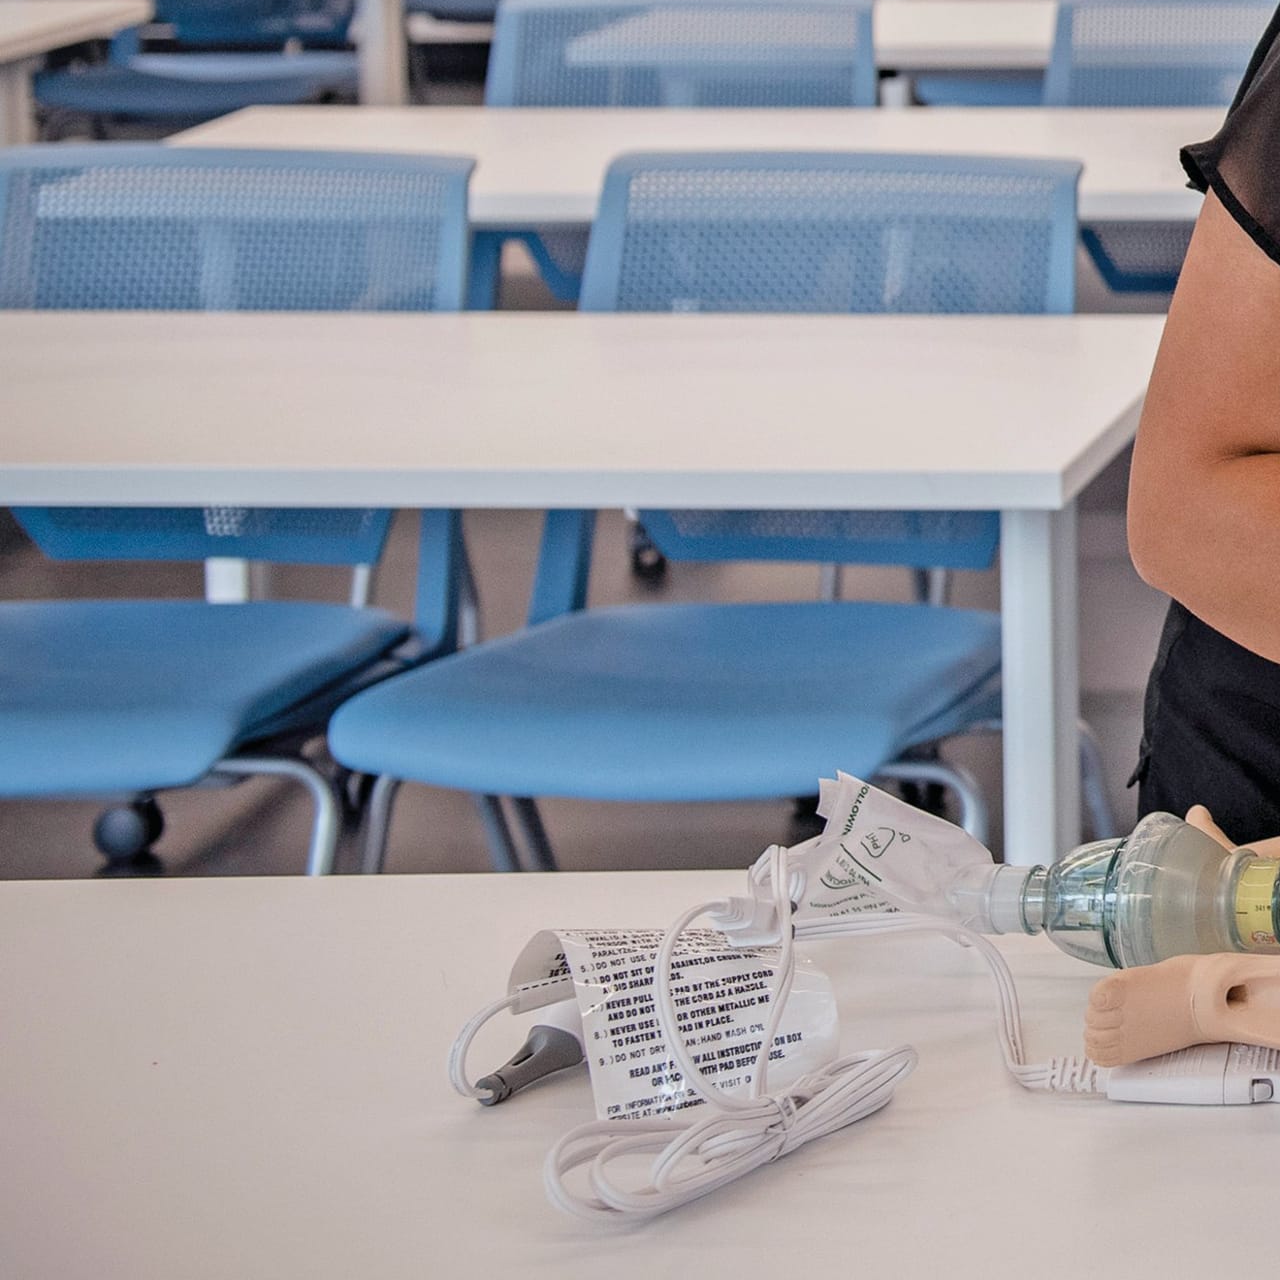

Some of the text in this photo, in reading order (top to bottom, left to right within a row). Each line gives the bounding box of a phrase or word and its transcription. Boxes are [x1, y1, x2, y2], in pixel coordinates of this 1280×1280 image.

[841, 784, 870, 836] OLLOWIN
[599, 975, 611, 984] DO
[613, 971, 628, 981] NOT
[630, 967, 643, 977] SIT
[610, 958, 626, 967] NOT
[630, 953, 647, 963] USE
[606, 997, 632, 1010] NEVER
[633, 993, 653, 1006] PULL
[693, 982, 703, 991] BY
[704, 979, 721, 990] THE
[721, 971, 750, 986] SUPPLY
[751, 969, 773, 980] CORD
[607, 1011, 624, 1022] AND
[626, 1008, 637, 1018] DO
[639, 1004, 656, 1015] NOT
[674, 996, 691, 1007] THE
[691, 991, 714, 1004] CORD
[716, 989, 726, 999] AS
[727, 988, 734, 997] A
[610, 1022, 637, 1037] NEVER
[638, 1019, 655, 1031] USE
[676, 1010, 688, 1022] OR
[690, 1003, 716, 1019] OTHER
[717, 997, 757, 1013] METALLIC
[612, 1038, 623, 1048] TO
[625, 1032, 656, 1046] FASTEN
[694, 1020, 704, 1030] IN
[705, 1015, 735, 1028] PLACE.
[629, 1066, 650, 1079] READ
[702, 1051, 717, 1063] ALL
[774, 1036, 786, 1046] ON
[786, 1032, 802, 1043] BOX
[630, 1048, 646, 1060] NOT
[649, 1044, 666, 1056] DRY
[651, 1076, 664, 1087] OR
[719, 1061, 735, 1072] PAD
[607, 1104, 621, 1115] FOR
